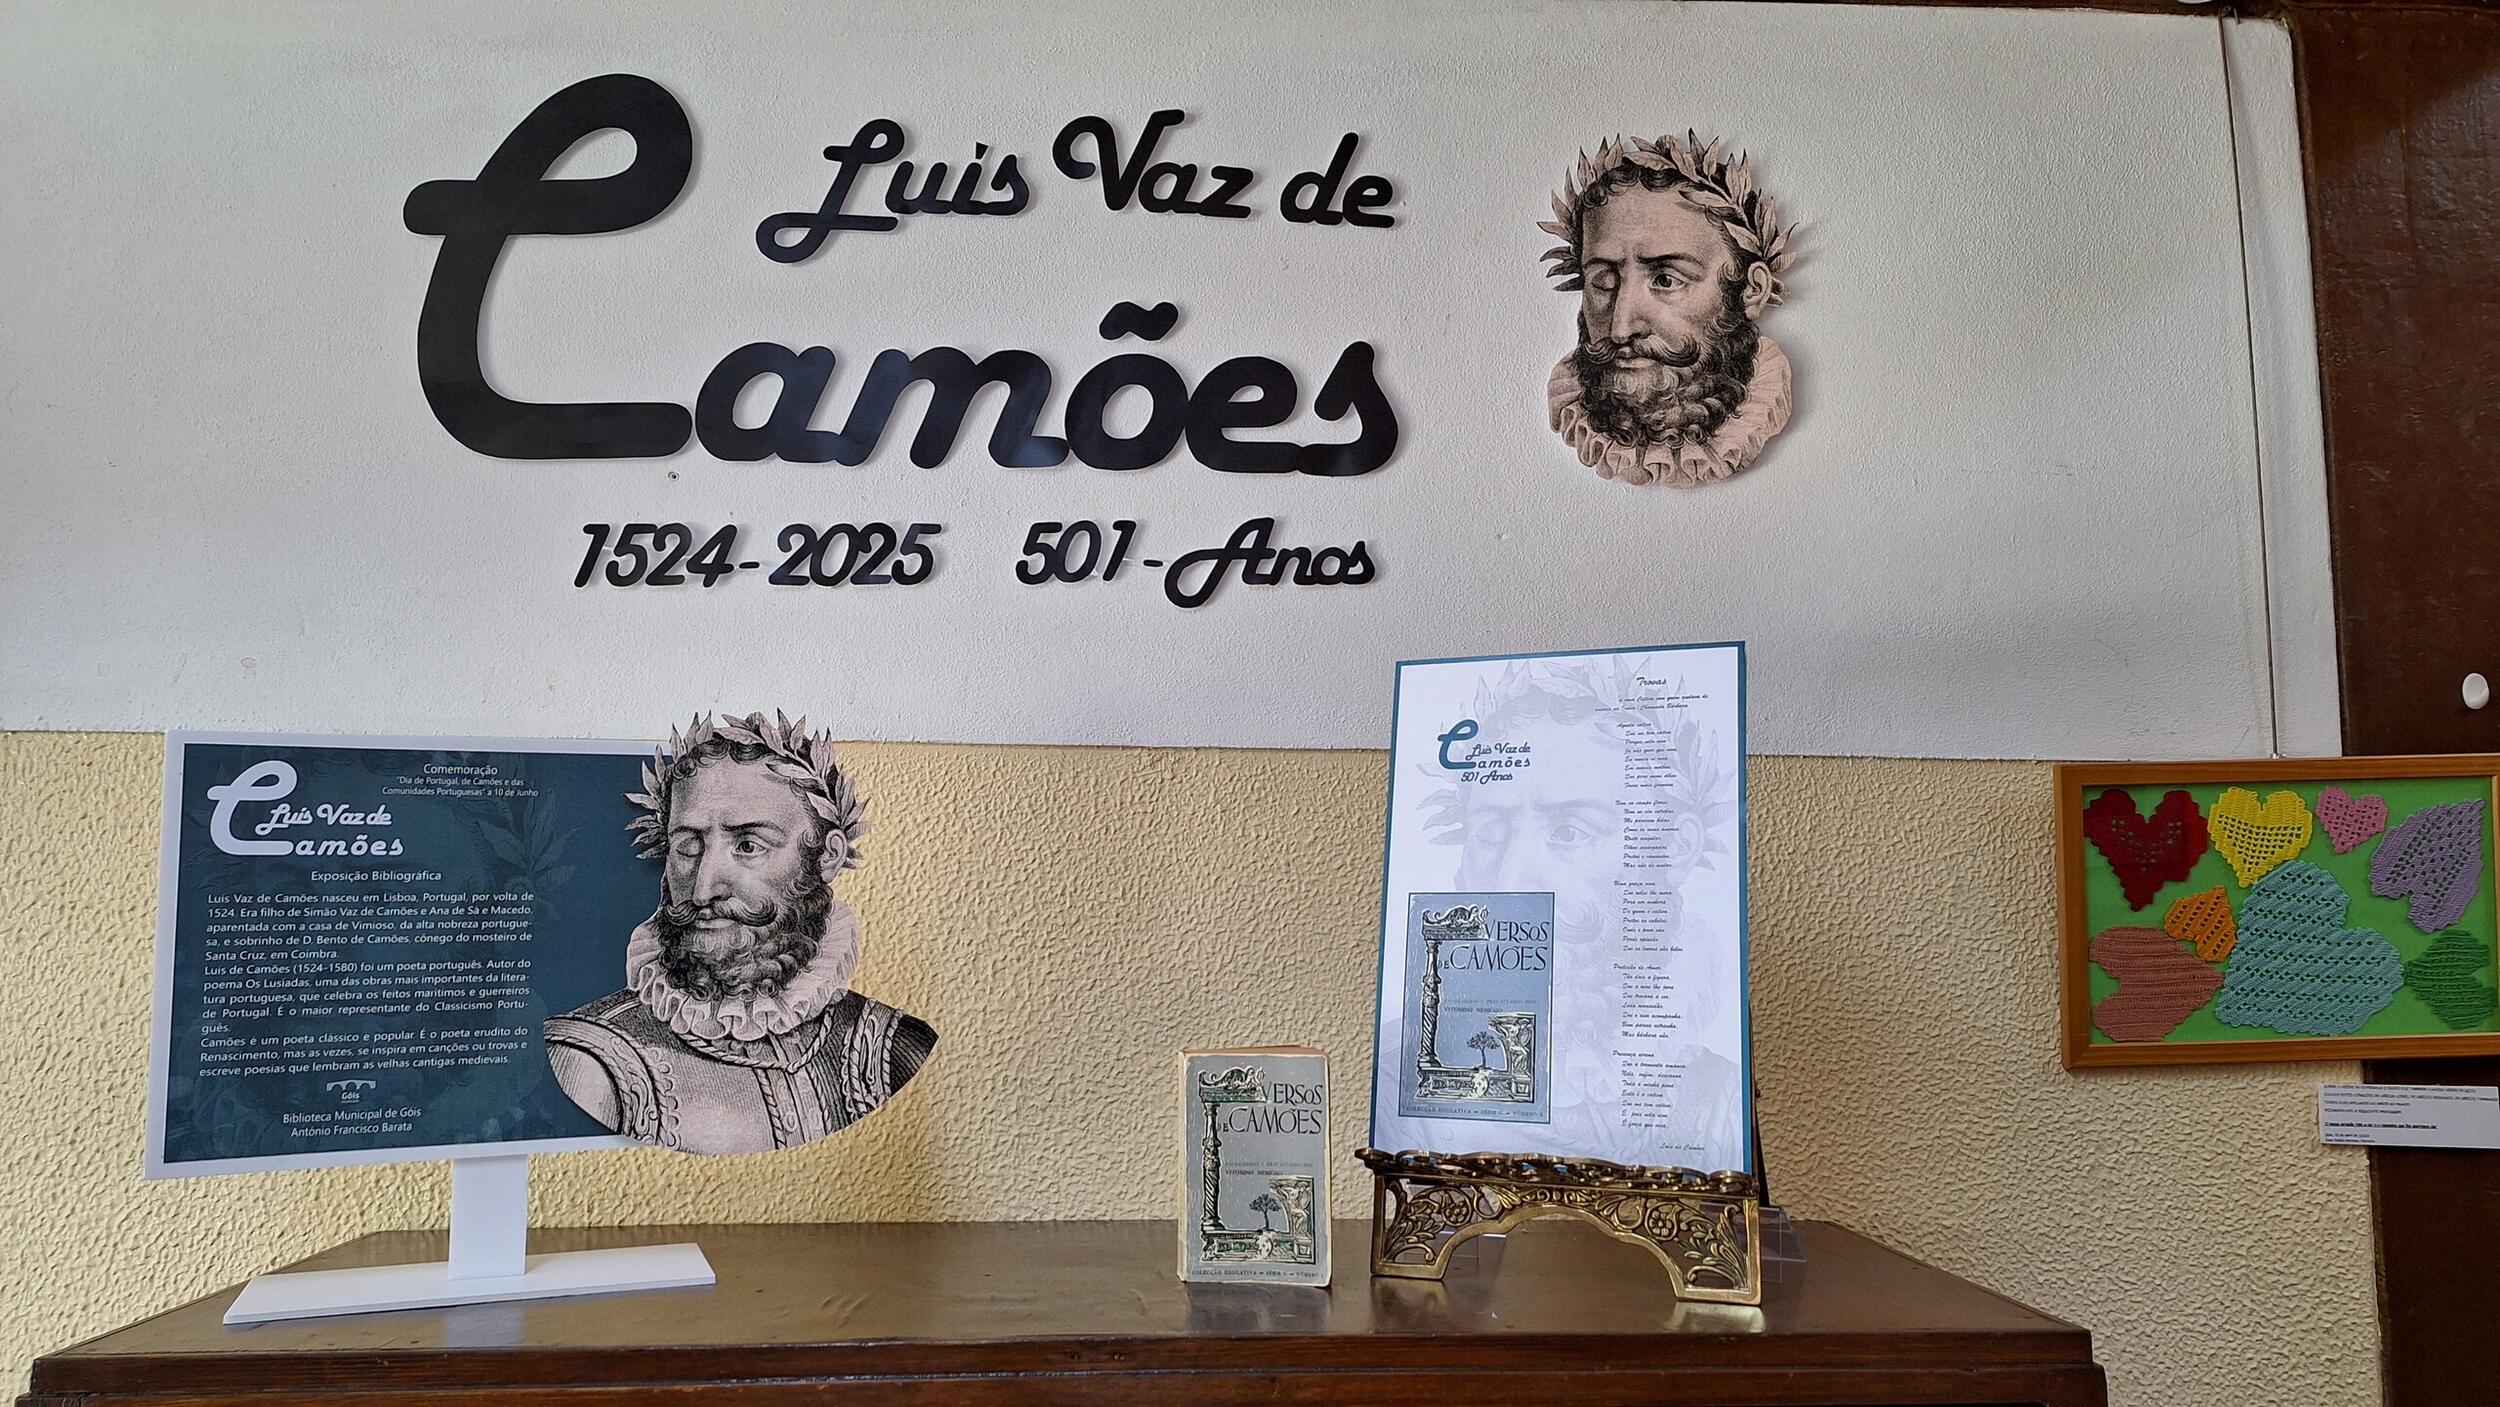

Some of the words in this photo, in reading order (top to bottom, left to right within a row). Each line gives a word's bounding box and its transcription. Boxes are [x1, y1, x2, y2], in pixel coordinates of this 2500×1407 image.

[755, 117, 1030, 264] Luís
[1051, 109, 1255, 218] Vaz
[1280, 131, 1395, 228] de
[403, 73, 1400, 477] Camões
[1636, 677, 1666, 686] Trovas
[1494, 742, 1517, 754] Vaz
[1518, 741, 1531, 753] de
[424, 763, 498, 777] Comemoração
[1461, 771, 1480, 782] 501
[1480, 770, 1513, 785] Anos
[414, 776, 424, 784] de
[473, 778, 502, 786] Camões
[382, 787, 435, 795] Comunidades
[207, 760, 403, 855] Camões
[317, 804, 365, 825] Vaz
[366, 804, 392, 825] de
[311, 871, 368, 882] Exposição
[372, 870, 442, 882] Bibliográfica
[234, 894, 253, 903] Vaz
[257, 893, 271, 903] de
[275, 893, 319, 903] Camões
[384, 893, 419, 903] Lisboa,
[423, 892, 468, 903] Portugal,
[472, 893, 489, 903] por
[493, 892, 518, 901] volta
[521, 892, 534, 901] de
[241, 908, 258, 917] Era
[260, 908, 285, 917] filho
[287, 907, 301, 917] de
[304, 907, 337, 917] Simão
[340, 907, 358, 916] Vaz
[360, 907, 374, 916] de
[376, 907, 418, 916] Camões
[429, 907, 449, 915] Ana
[452, 906, 465, 915] de
[206, 923, 269, 934] aparentada
[335, 921, 349, 930] de
[400, 920, 413, 929] da
[416, 920, 434, 929] alta
[437, 920, 479, 929] nobreza
[482, 921, 532, 931] portugue-
[205, 938, 220, 947] sa,
[234, 936, 283, 946] sobrinho
[286, 936, 300, 945] de
[316, 935, 348, 944] Bento
[351, 935, 364, 944] de
[456, 933, 470, 942] do
[472, 933, 517, 942] mosteiro
[519, 933, 532, 941] de
[205, 951, 236, 961] Santa
[1450, 944, 1548, 972] CAMÕES
[229, 965, 243, 975] de
[247, 965, 290, 974] Camões
[293, 963, 358, 974] (1524-1580)
[360, 962, 374, 971] foi
[377, 963, 394, 971] um
[397, 962, 427, 972] poeta
[486, 959, 516, 969] Autor
[517, 959, 531, 968] do
[203, 980, 242, 991] poema
[245, 979, 261, 988] Os
[341, 976, 359, 986] das
[362, 976, 392, 986] obras
[395, 975, 419, 984] mais
[421, 974, 483, 985] importantes
[486, 973, 499, 982] da
[501, 973, 530, 982] litera-
[203, 995, 225, 1004] tura
[229, 993, 295, 1005] portuguesa,
[299, 993, 320, 1003] que
[324, 991, 362, 1000] celebra
[382, 990, 411, 998] feitos
[479, 987, 530, 998] guerreiros
[202, 1009, 217, 1019] de
[302, 1006, 333, 1015] maior
[338, 1005, 411, 1015] representante
[415, 1002, 430, 1012] do
[434, 1001, 493, 1011] Classicismo
[497, 1000, 528, 1008] Portu-
[200, 1038, 246, 1048] Camões
[261, 1037, 279, 1045] um
[283, 1035, 314, 1046] poeta
[318, 1033, 359, 1043] clássico
[441, 1029, 470, 1039] poeta
[474, 1027, 511, 1037] erudito
[514, 1026, 528, 1035] do
[200, 1051, 280, 1062] Renascimento,
[284, 1050, 306, 1058] mas
[372, 1044, 407, 1055] inspira
[410, 1045, 426, 1053] em
[428, 1042, 470, 1053] canções
[488, 1041, 518, 1050] trovas
[199, 1067, 241, 1076] escreve
[244, 1064, 286, 1076] poesias
[289, 1064, 309, 1073] que
[312, 1061, 359, 1071] lembram
[377, 1058, 410, 1068] velhas
[413, 1056, 455, 1067] cantigas
[342, 1091, 360, 1100] Góis
[283, 1112, 332, 1124] Biblioteca
[335, 1108, 382, 1121] Municipal
[385, 1108, 397, 1118] de
[400, 1105, 422, 1117] Góis
[1229, 1106, 1322, 1134] CAMÕES
[290, 1124, 331, 1137] António
[334, 1124, 379, 1135] Francisco
[382, 1122, 412, 1132] Barata
